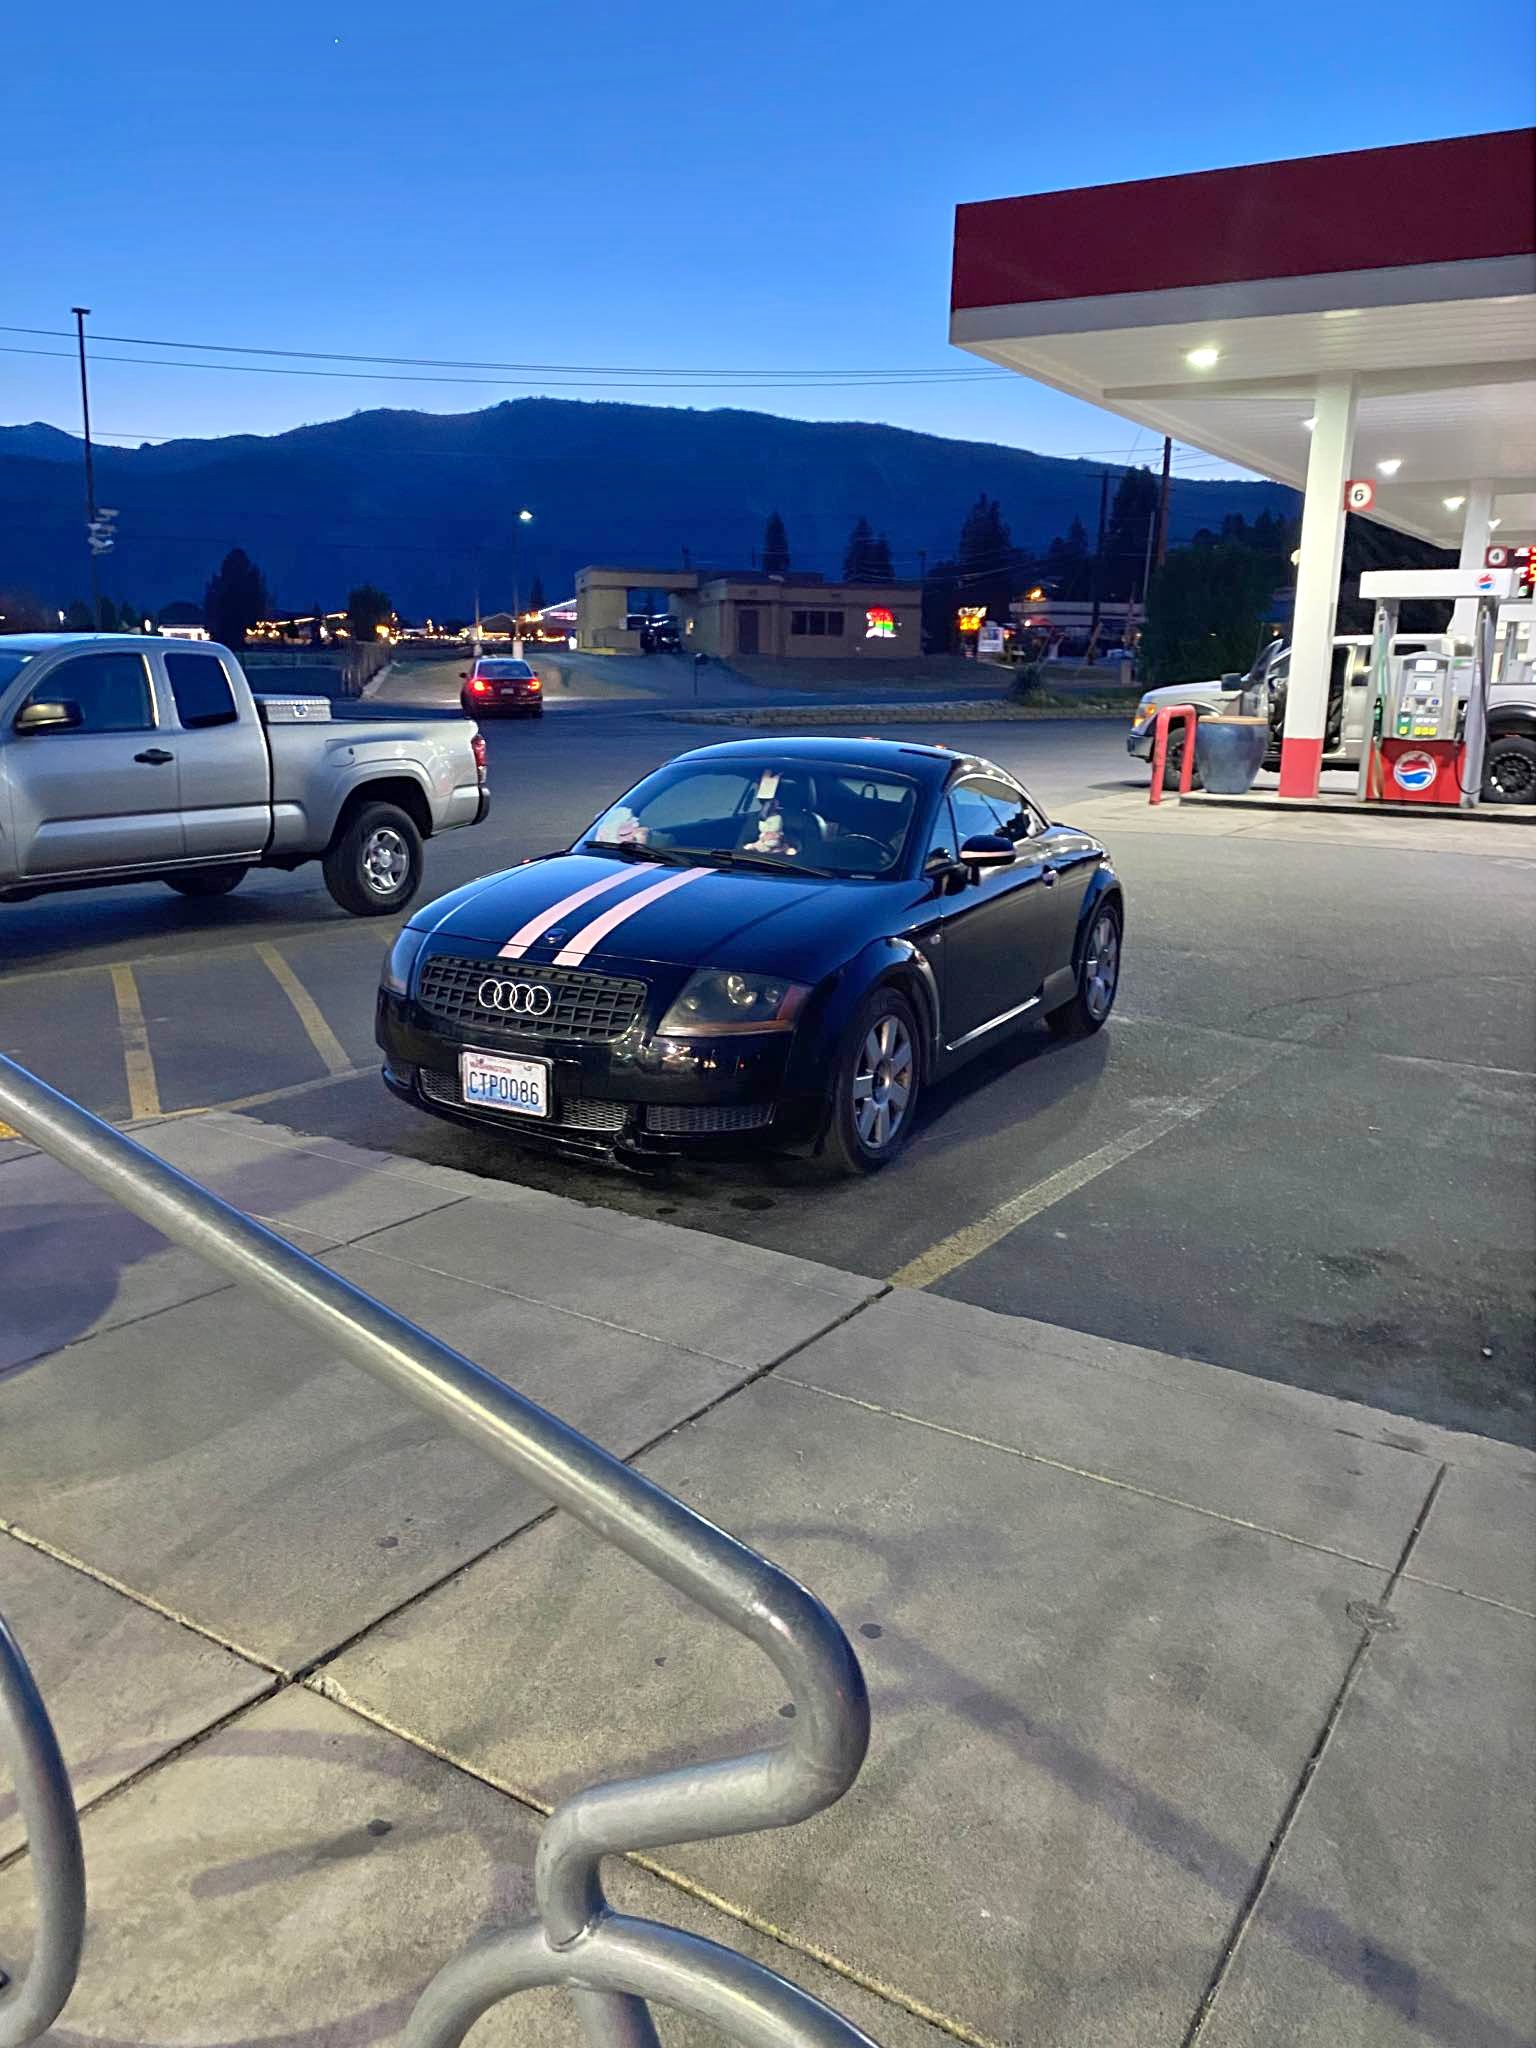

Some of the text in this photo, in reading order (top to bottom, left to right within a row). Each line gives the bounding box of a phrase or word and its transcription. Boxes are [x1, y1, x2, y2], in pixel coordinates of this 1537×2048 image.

[1354, 489, 1364, 502] 6
[1492, 551, 1500, 561] 4
[469, 1071, 539, 1105] CTP0086
